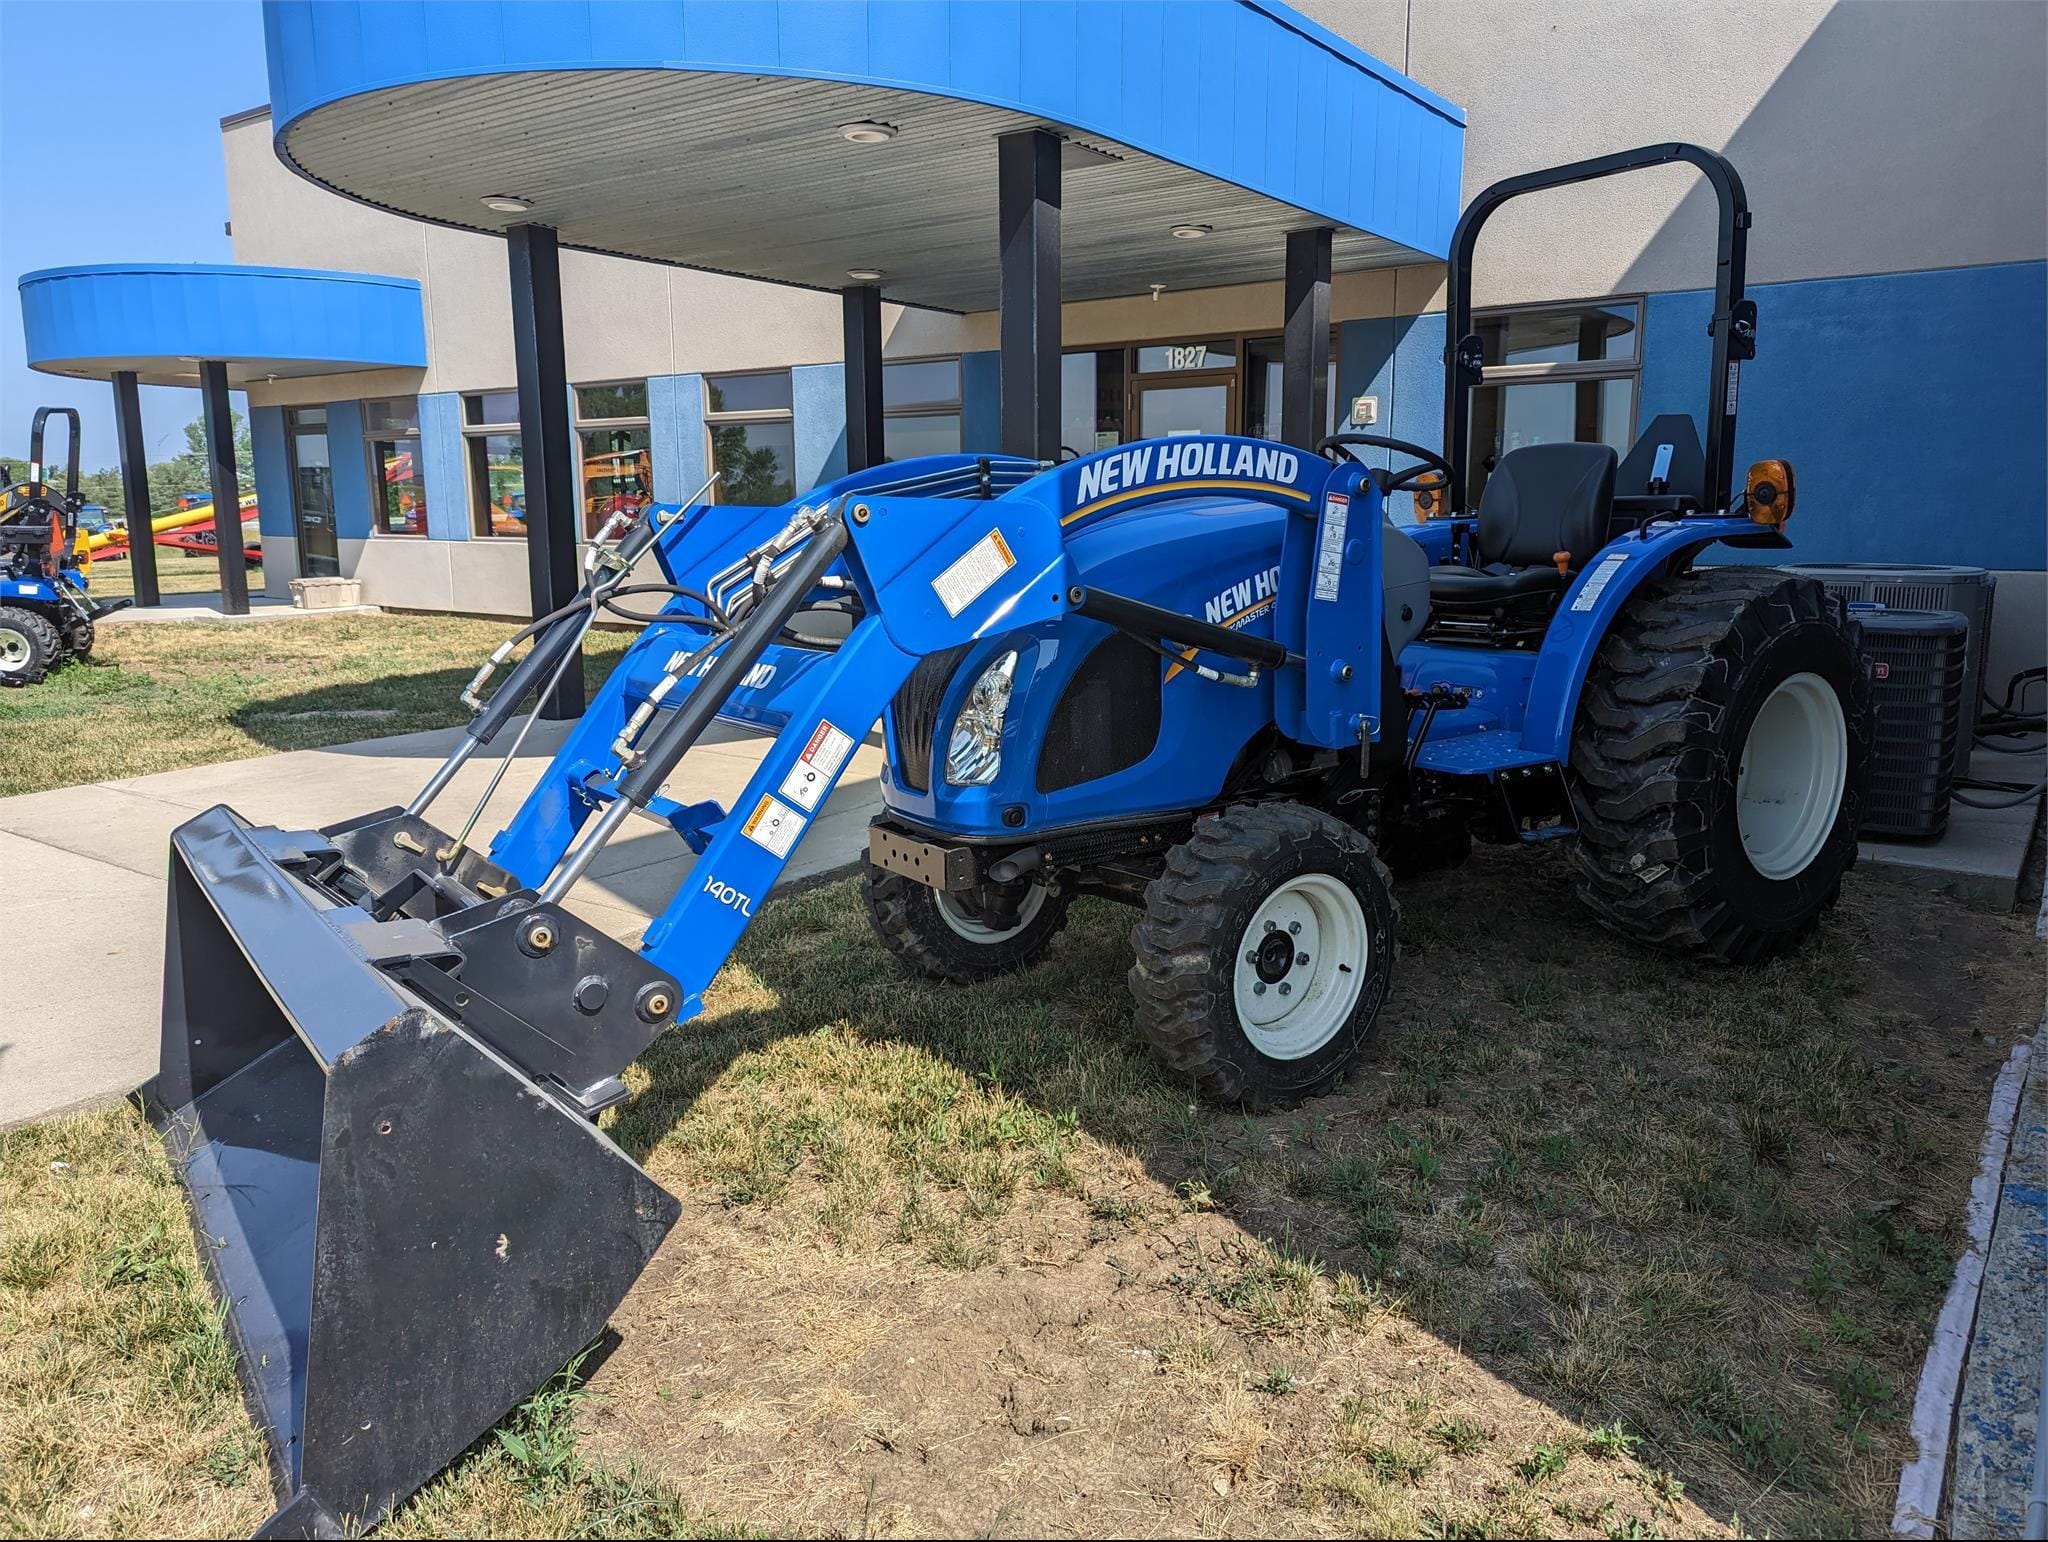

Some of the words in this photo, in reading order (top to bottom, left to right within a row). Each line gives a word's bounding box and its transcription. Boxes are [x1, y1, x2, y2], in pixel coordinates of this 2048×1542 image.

[1165, 346, 1207, 369] 1827
[1077, 447, 1152, 504] NEW
[1157, 443, 1298, 485] HOLLAND
[1205, 578, 1251, 624] NEW
[810, 726, 828, 753] DANGER
[703, 874, 751, 917] 140TL
